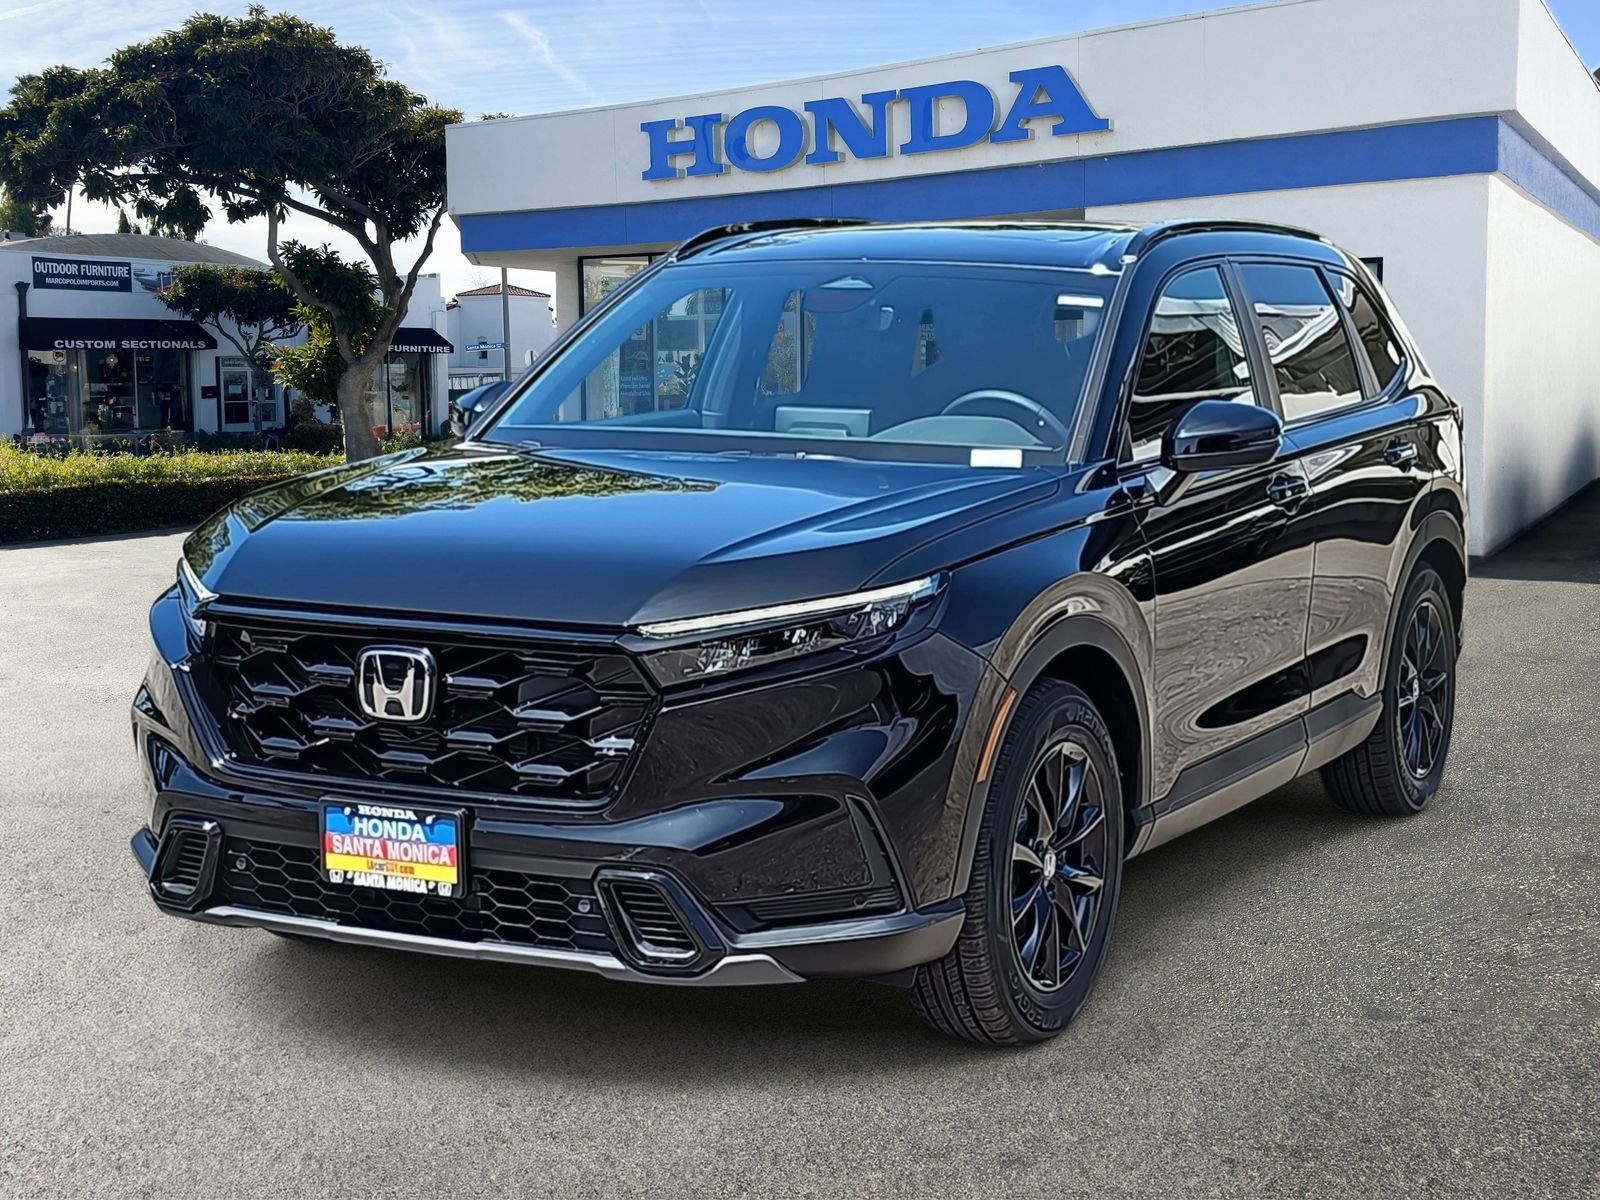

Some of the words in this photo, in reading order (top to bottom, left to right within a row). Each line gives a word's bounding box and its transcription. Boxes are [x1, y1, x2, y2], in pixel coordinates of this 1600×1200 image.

[640, 64, 1113, 181] HONDA
[34, 261, 78, 275] OUTDOOR
[80, 265, 129, 278] FURNITURE
[46, 277, 119, 287] MARCOPOLOIMPORTS.COM
[54, 340, 115, 349] CUSTOM
[121, 340, 206, 349] SECTIONALS
[388, 344, 450, 353] FURNITURE
[358, 805, 418, 820] HONDA
[354, 817, 426, 842] HONDA
[332, 835, 384, 858] SANTA
[387, 841, 451, 865] MONICA
[353, 872, 385, 889] SANTA
[387, 875, 428, 894] MONICA
